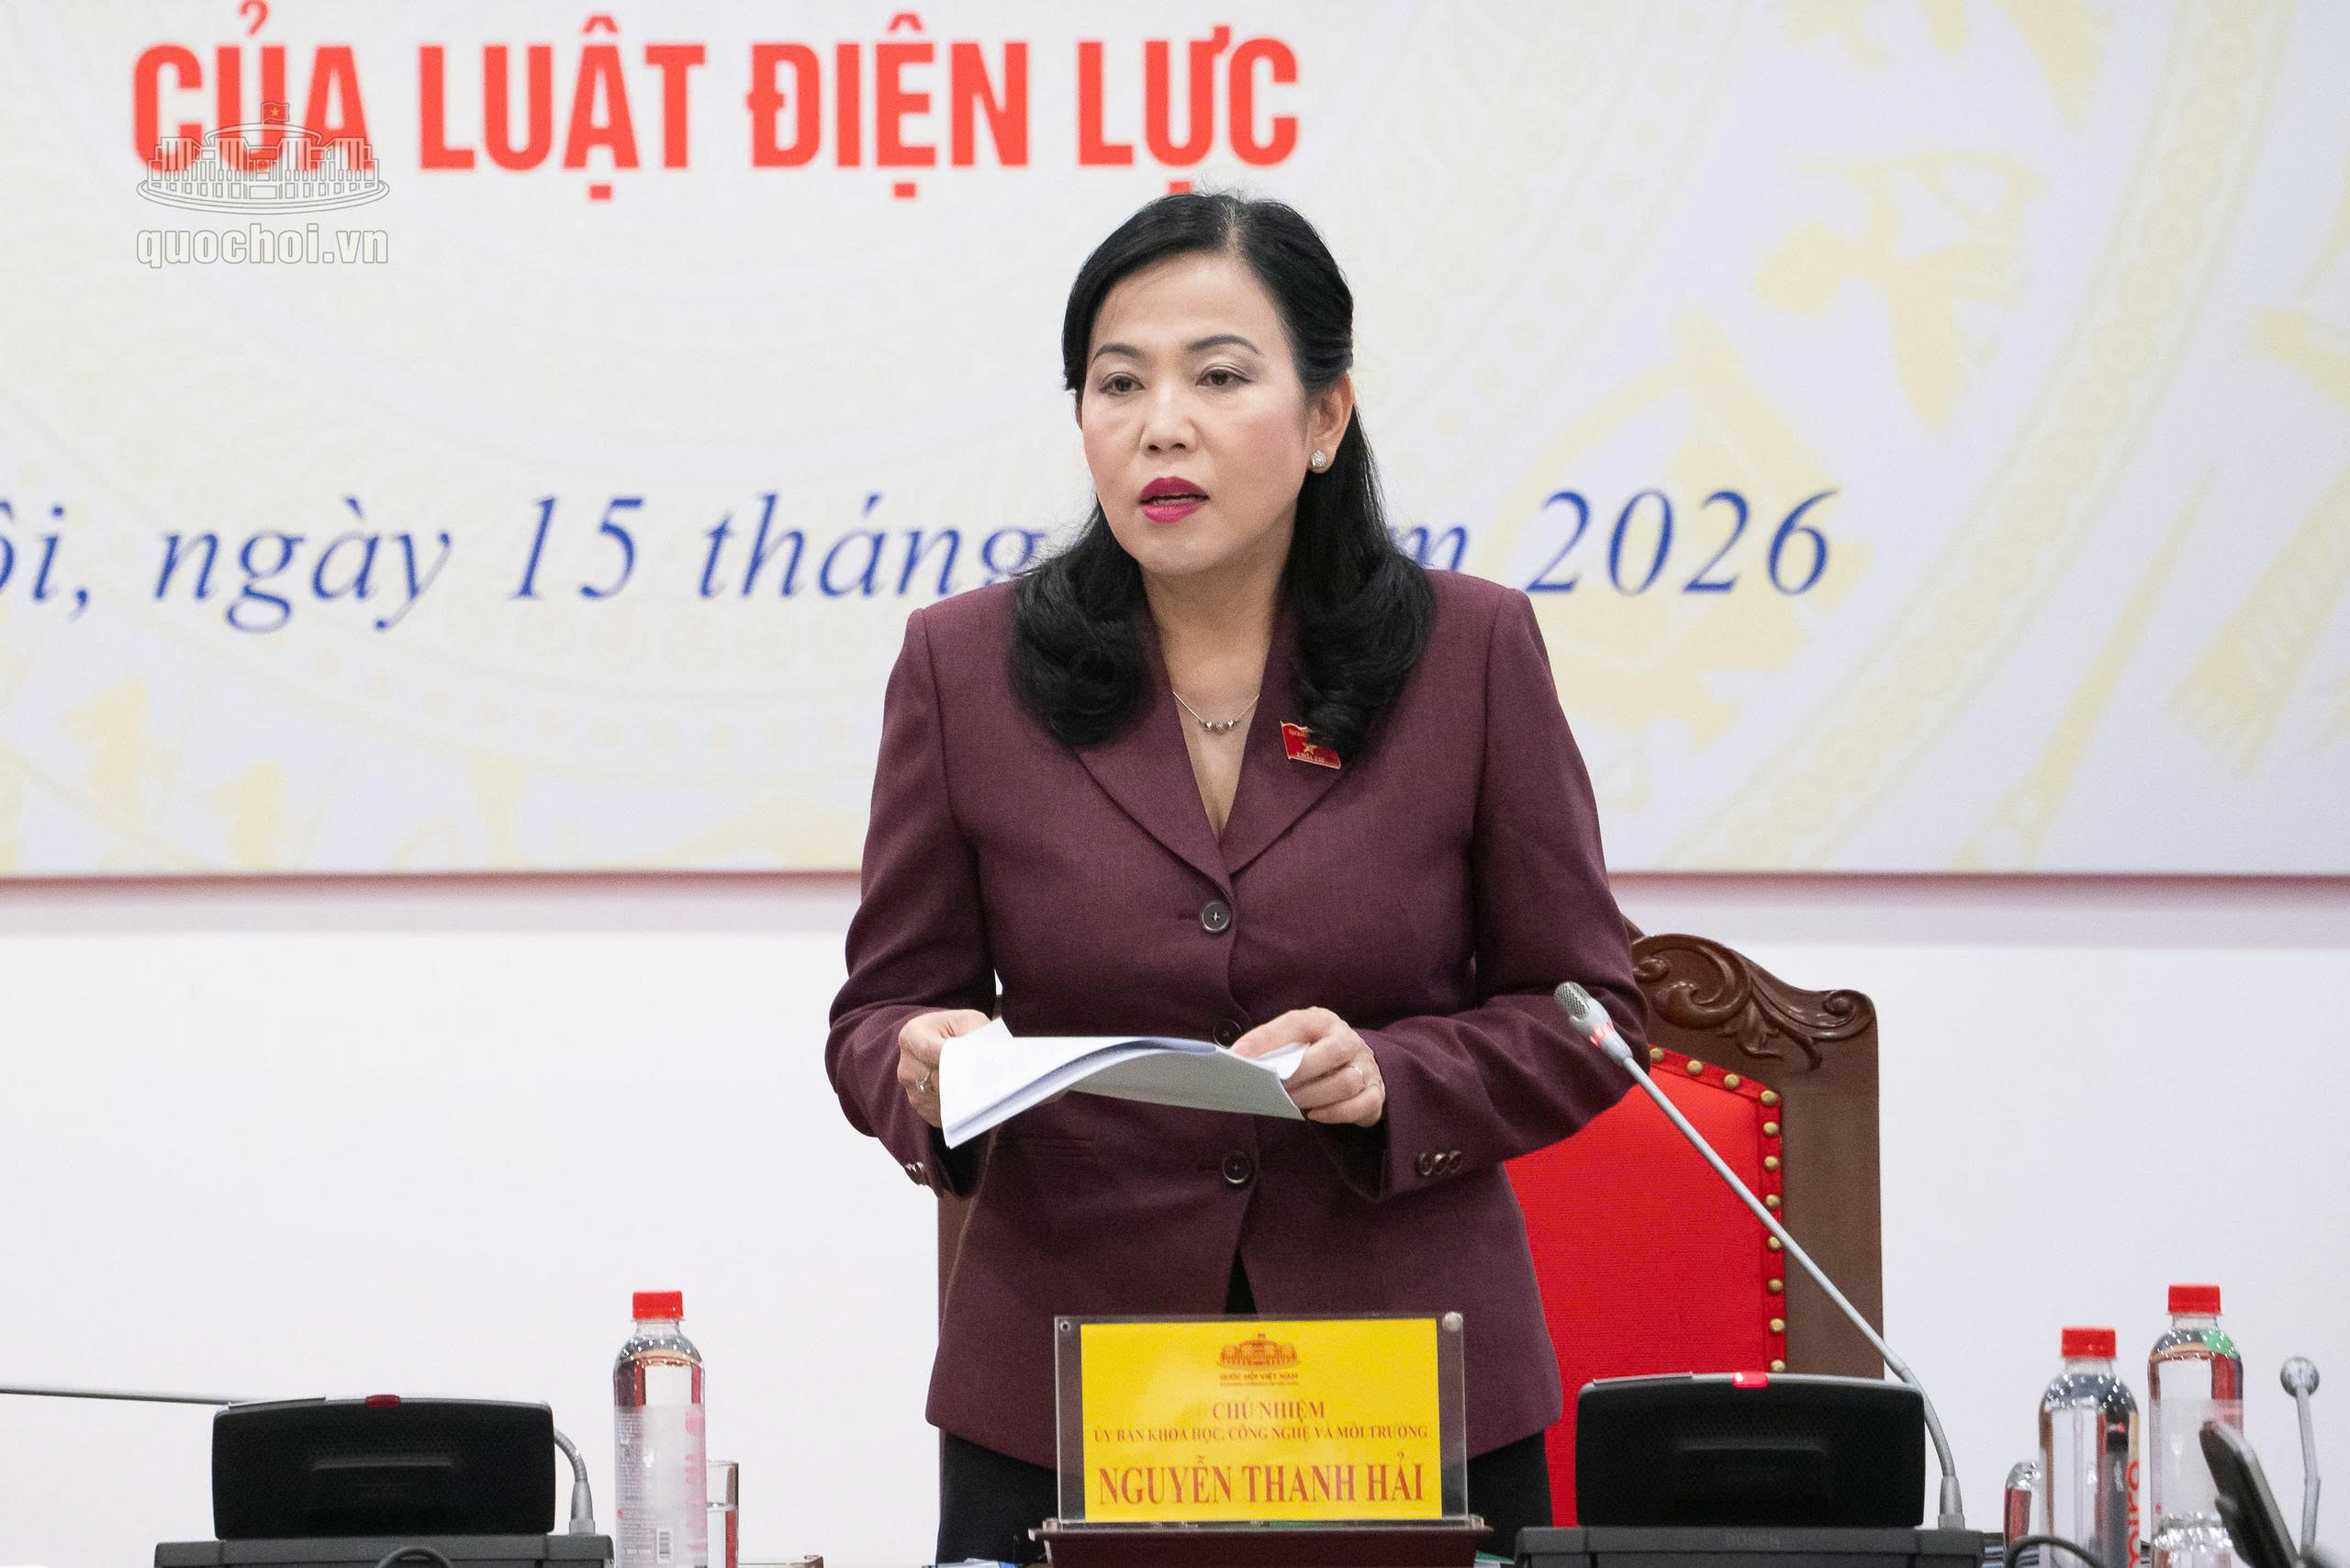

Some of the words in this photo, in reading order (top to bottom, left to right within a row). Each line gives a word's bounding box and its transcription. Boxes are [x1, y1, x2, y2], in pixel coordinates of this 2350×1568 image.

[132, 0, 375, 174] CỦA
[418, 14, 706, 202] LUẬT
[745, 12, 1029, 200] ĐIỆN
[1077, 25, 1299, 194] LỰC
[153, 496, 452, 633] ngày
[510, 496, 645, 600] 15
[1525, 488, 1839, 596] 2026
[1116, 1428, 1145, 1442] BAN
[1147, 1428, 1188, 1442] KHOA
[1228, 1424, 1269, 1441] CÔNG
[1271, 1424, 1308, 1443] NGHỆ
[1314, 1424, 1334, 1440] VÀ
[1337, 1423, 1365, 1440] MÔI
[1259, 1398, 1326, 1422] NHIỆM
[1099, 1455, 1232, 1506] NGUYỄN
[1241, 1464, 1357, 1503] THANH
[1367, 1451, 1425, 1502] HẢI
